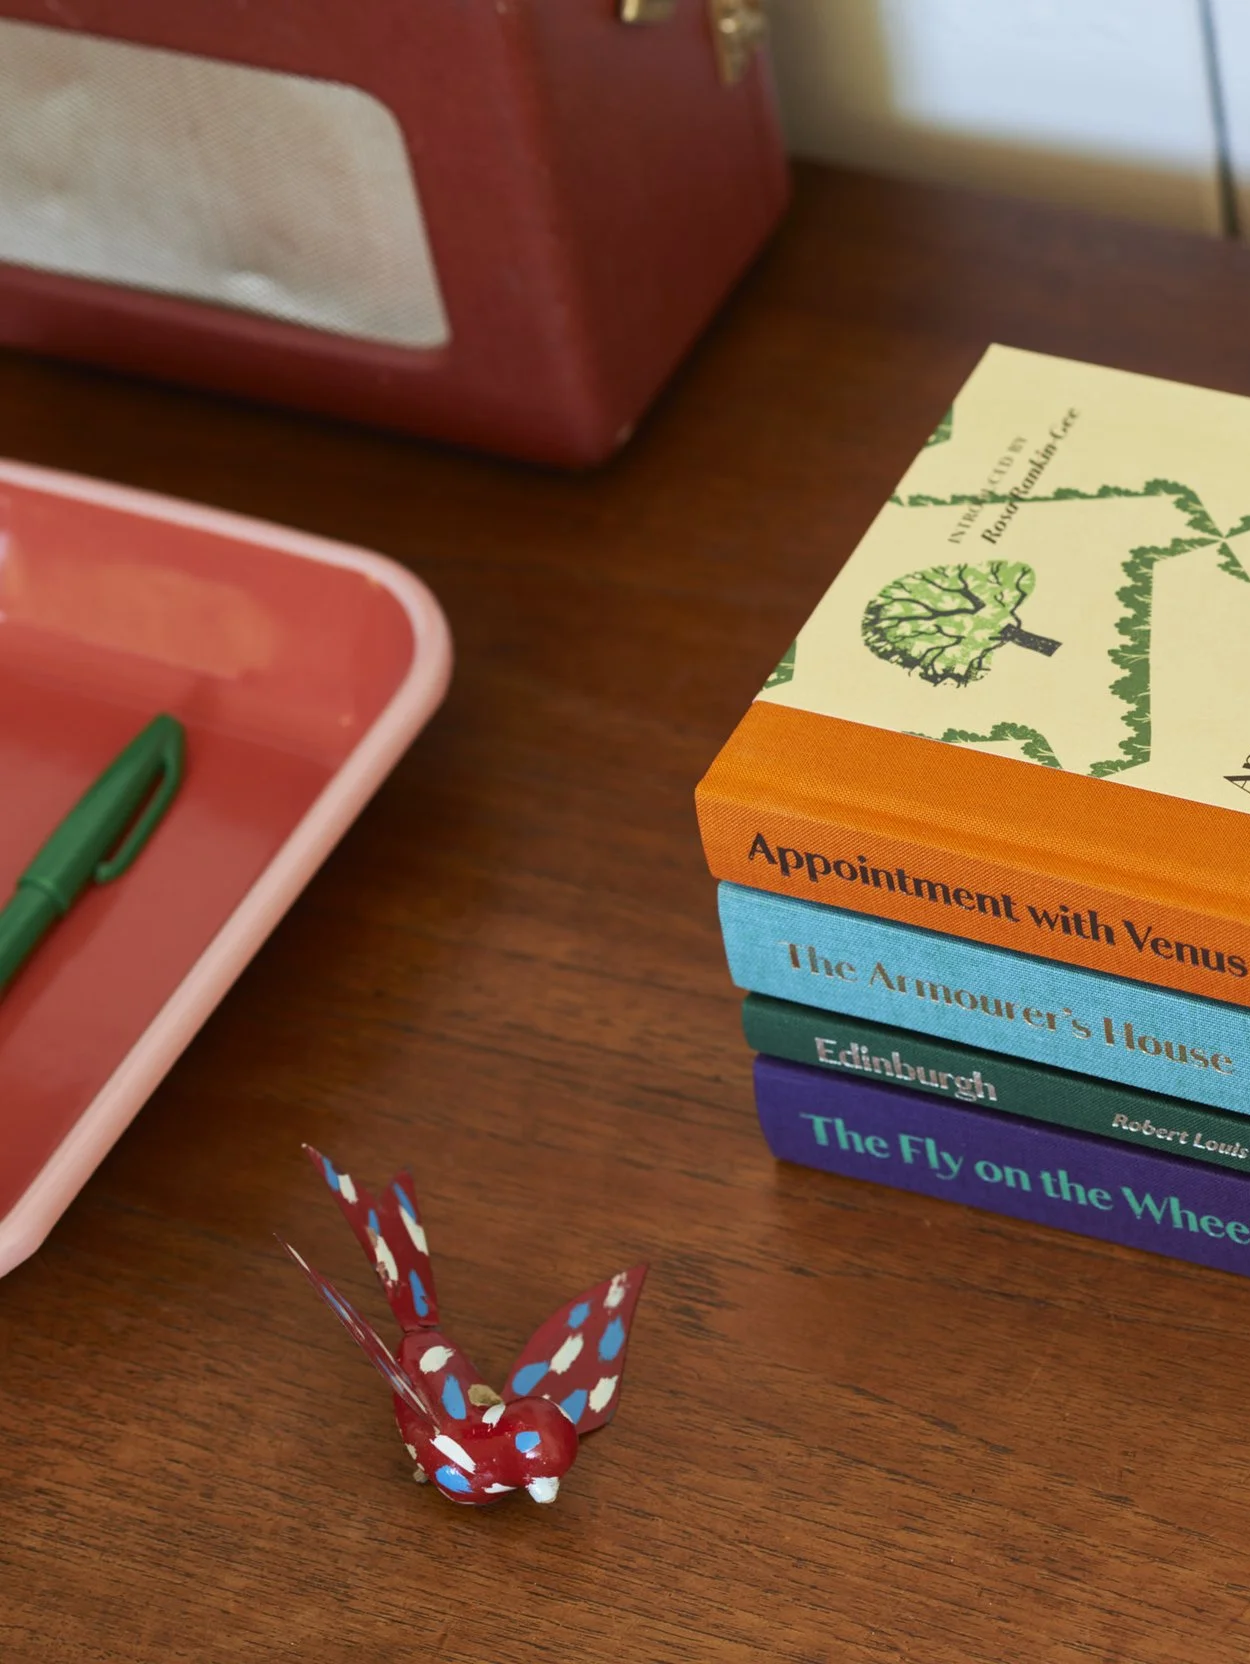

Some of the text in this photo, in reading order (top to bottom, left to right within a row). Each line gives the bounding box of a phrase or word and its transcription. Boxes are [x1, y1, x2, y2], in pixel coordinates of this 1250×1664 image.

[981, 502, 1019, 544] Rosa
[748, 832, 1248, 978] Appointment with Venus
[778, 941, 1235, 1075] The Armourer's House
[814, 1037, 997, 1101] Edinburgh
[800, 1112, 890, 1158] The
[899, 1133, 963, 1180] Fly
[974, 1160, 1031, 1191] on
[1039, 1169, 1113, 1210] the
[1112, 1113, 1188, 1144] Robert
[1193, 1132, 1249, 1159] Louis
